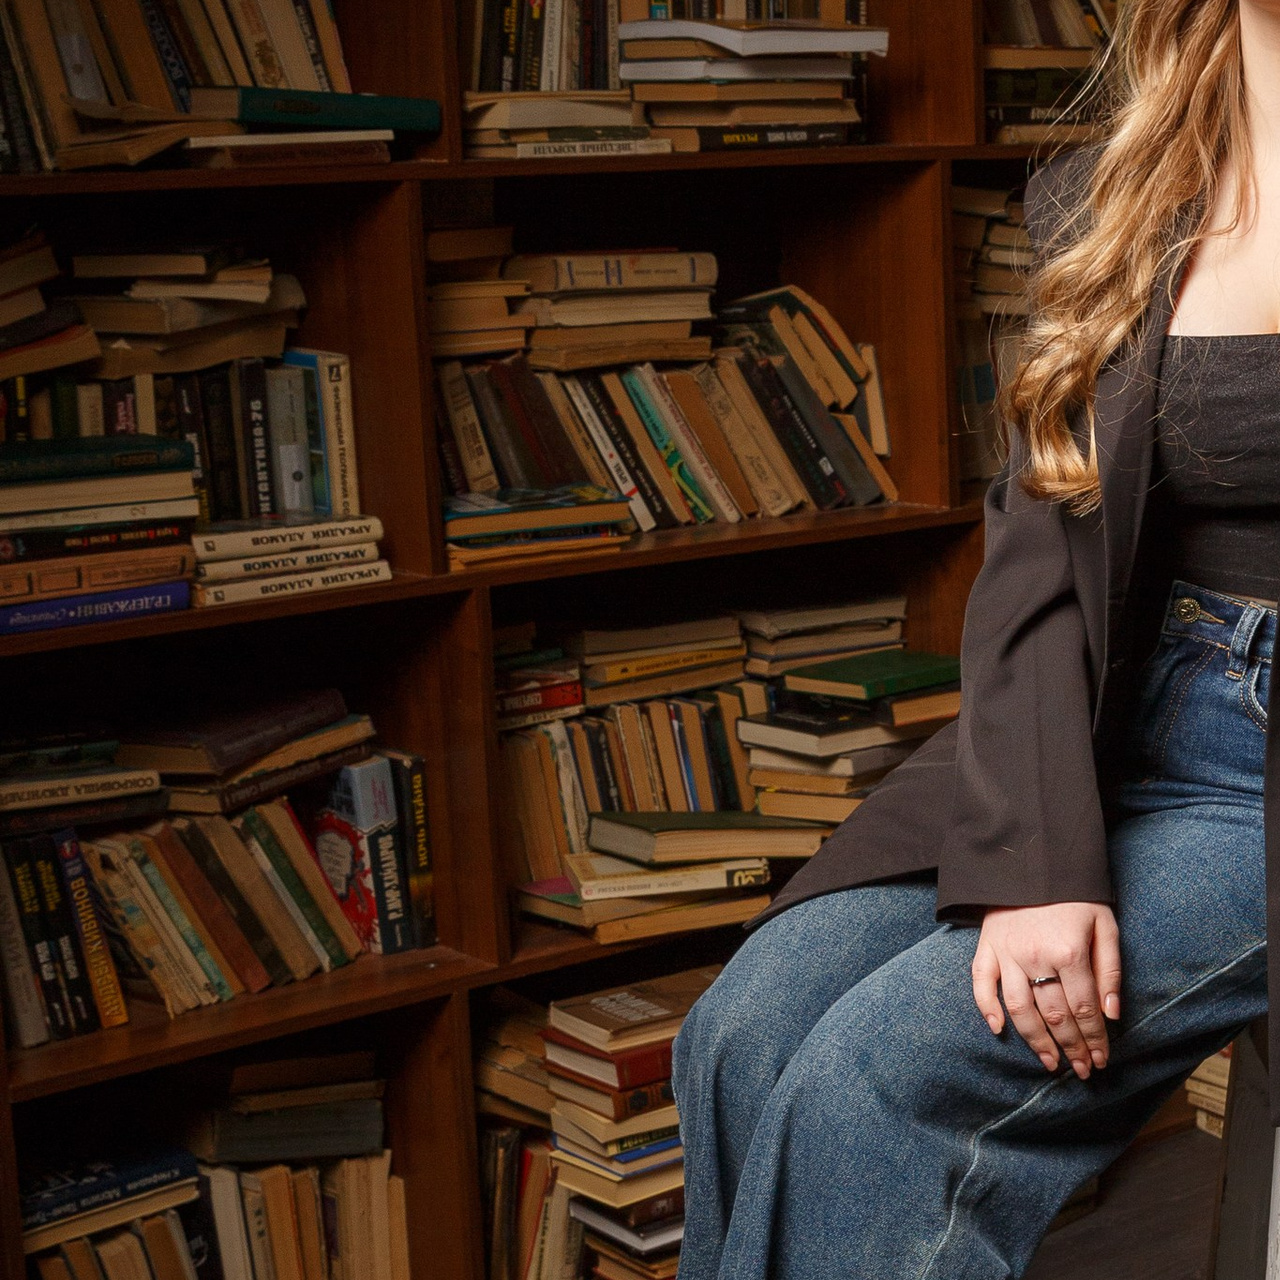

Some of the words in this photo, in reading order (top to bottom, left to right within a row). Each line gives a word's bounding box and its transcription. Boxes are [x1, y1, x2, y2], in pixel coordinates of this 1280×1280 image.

[251, 531, 305, 546] АДАМОВ
[312, 524, 372, 543] АРКАДИЙ
[243, 556, 298, 573] АДАМОВ
[305, 549, 367, 567] АРКАДИЙ
[260, 577, 313, 594] АДАМОВ
[320, 568, 381, 586] АРКАДИЙ
[72, 775, 154, 795] СОКРОВИЩА
[71, 878, 101, 950] КИВИНОВ
[90, 950, 121, 1021] АНДРЕЙ
